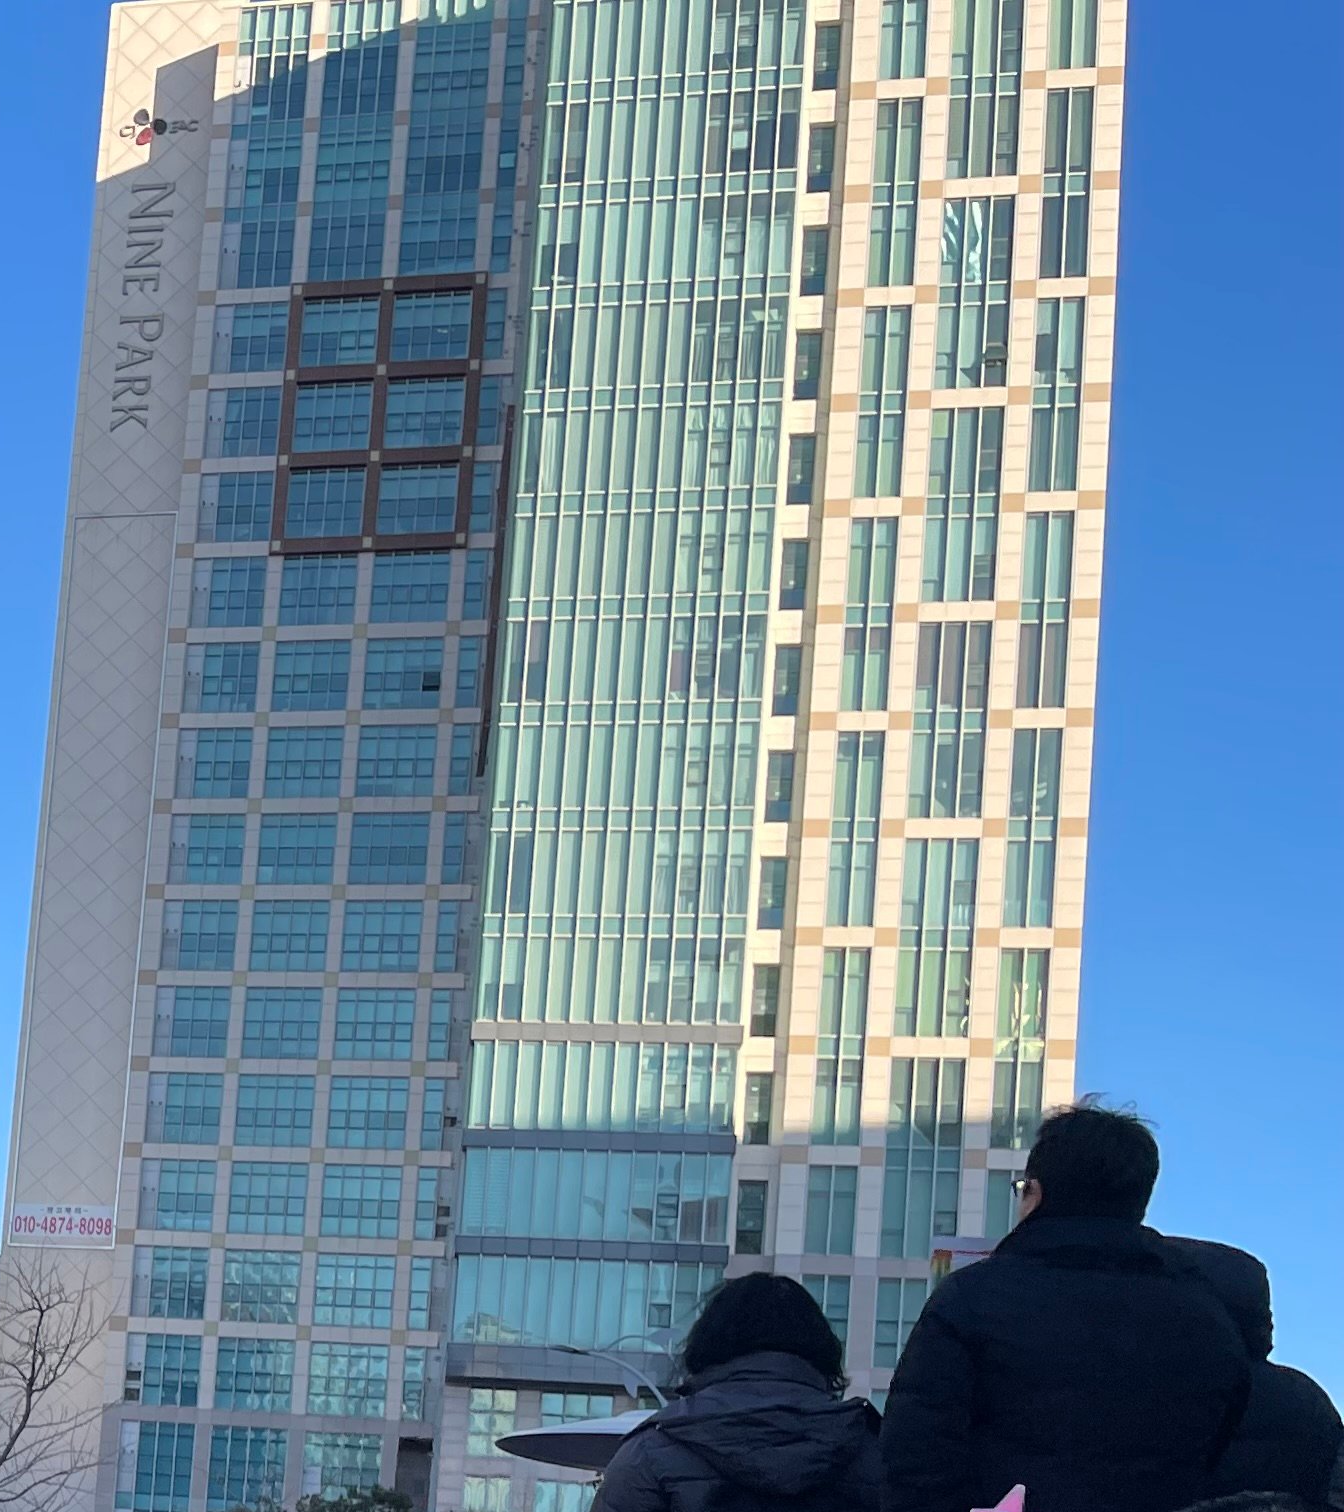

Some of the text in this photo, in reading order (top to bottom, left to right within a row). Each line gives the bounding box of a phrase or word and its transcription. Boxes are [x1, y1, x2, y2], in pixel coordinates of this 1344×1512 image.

[109, 181, 176, 433] NINE PARK
[13, 1215, 113, 1236] 010-4874-8098
